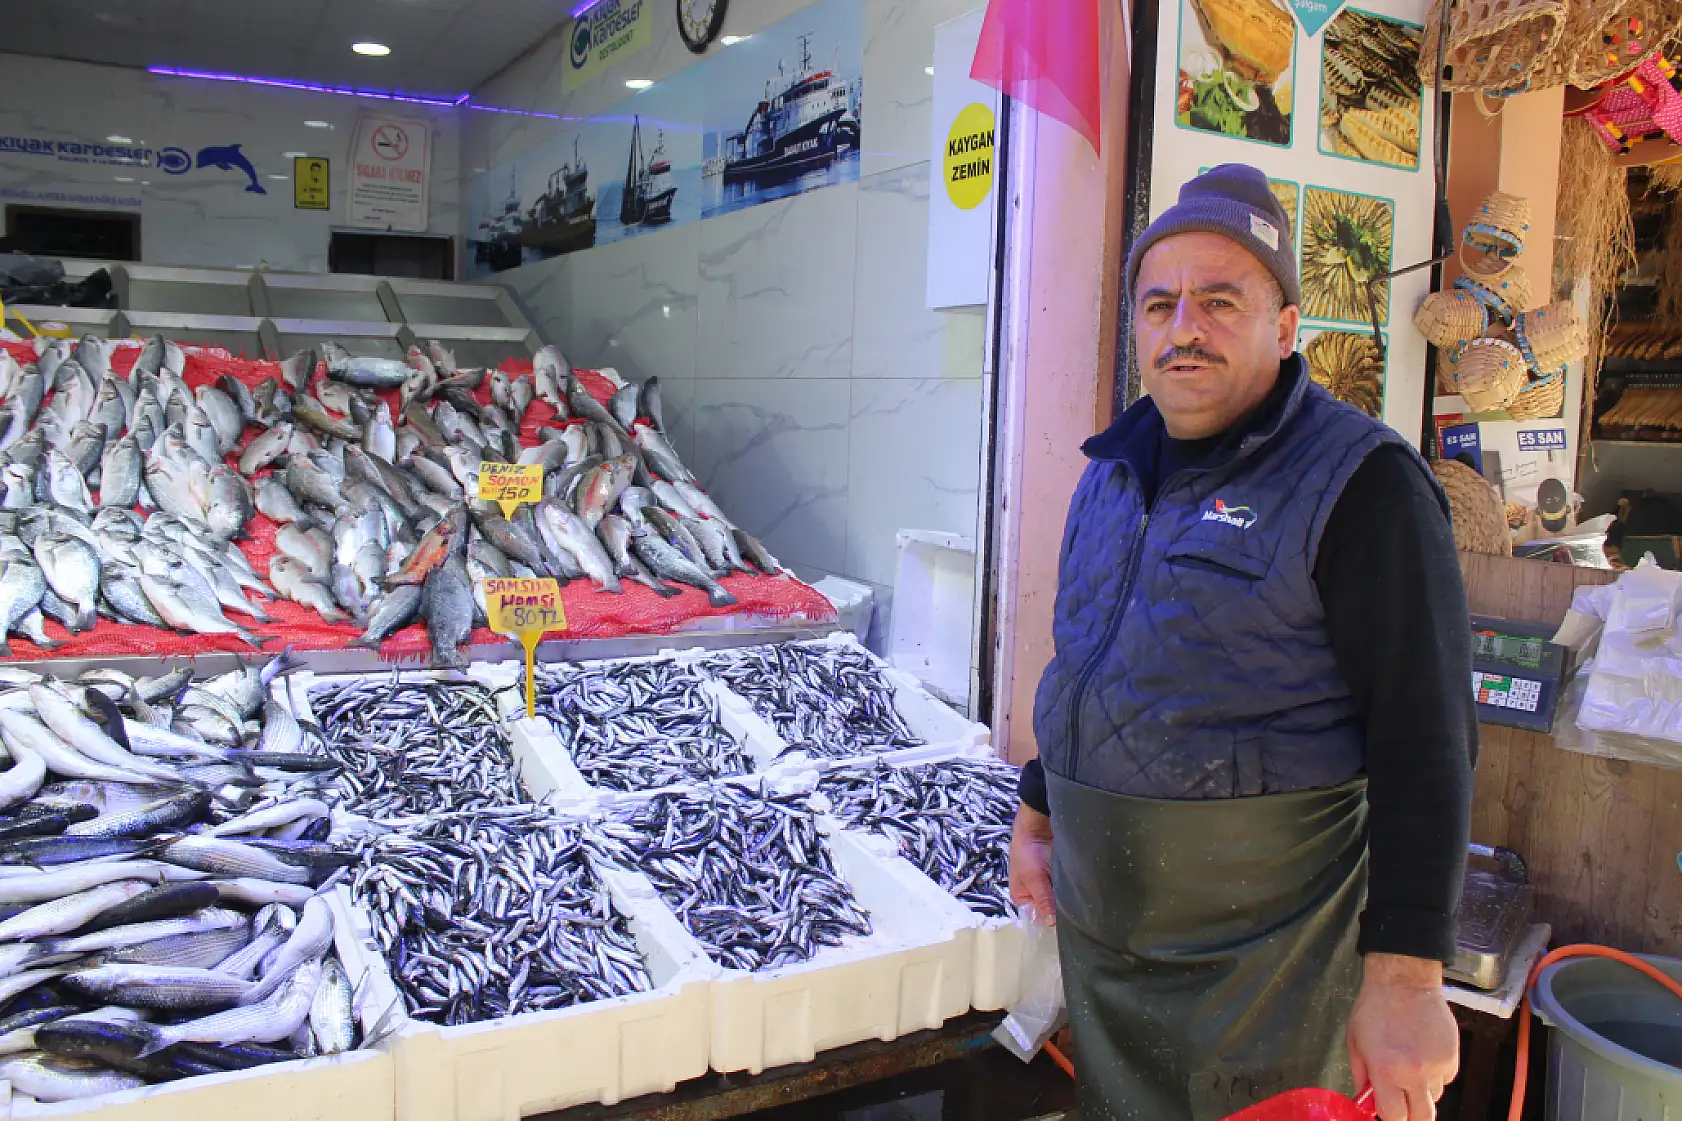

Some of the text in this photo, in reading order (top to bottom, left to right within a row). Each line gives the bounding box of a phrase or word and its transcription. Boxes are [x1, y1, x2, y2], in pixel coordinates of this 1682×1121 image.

[948, 129, 994, 157] KAYGAN
[951, 157, 990, 182] ZEMİN
[1518, 430, 1563, 446] ES SAN
[496, 486, 531, 500] 150
